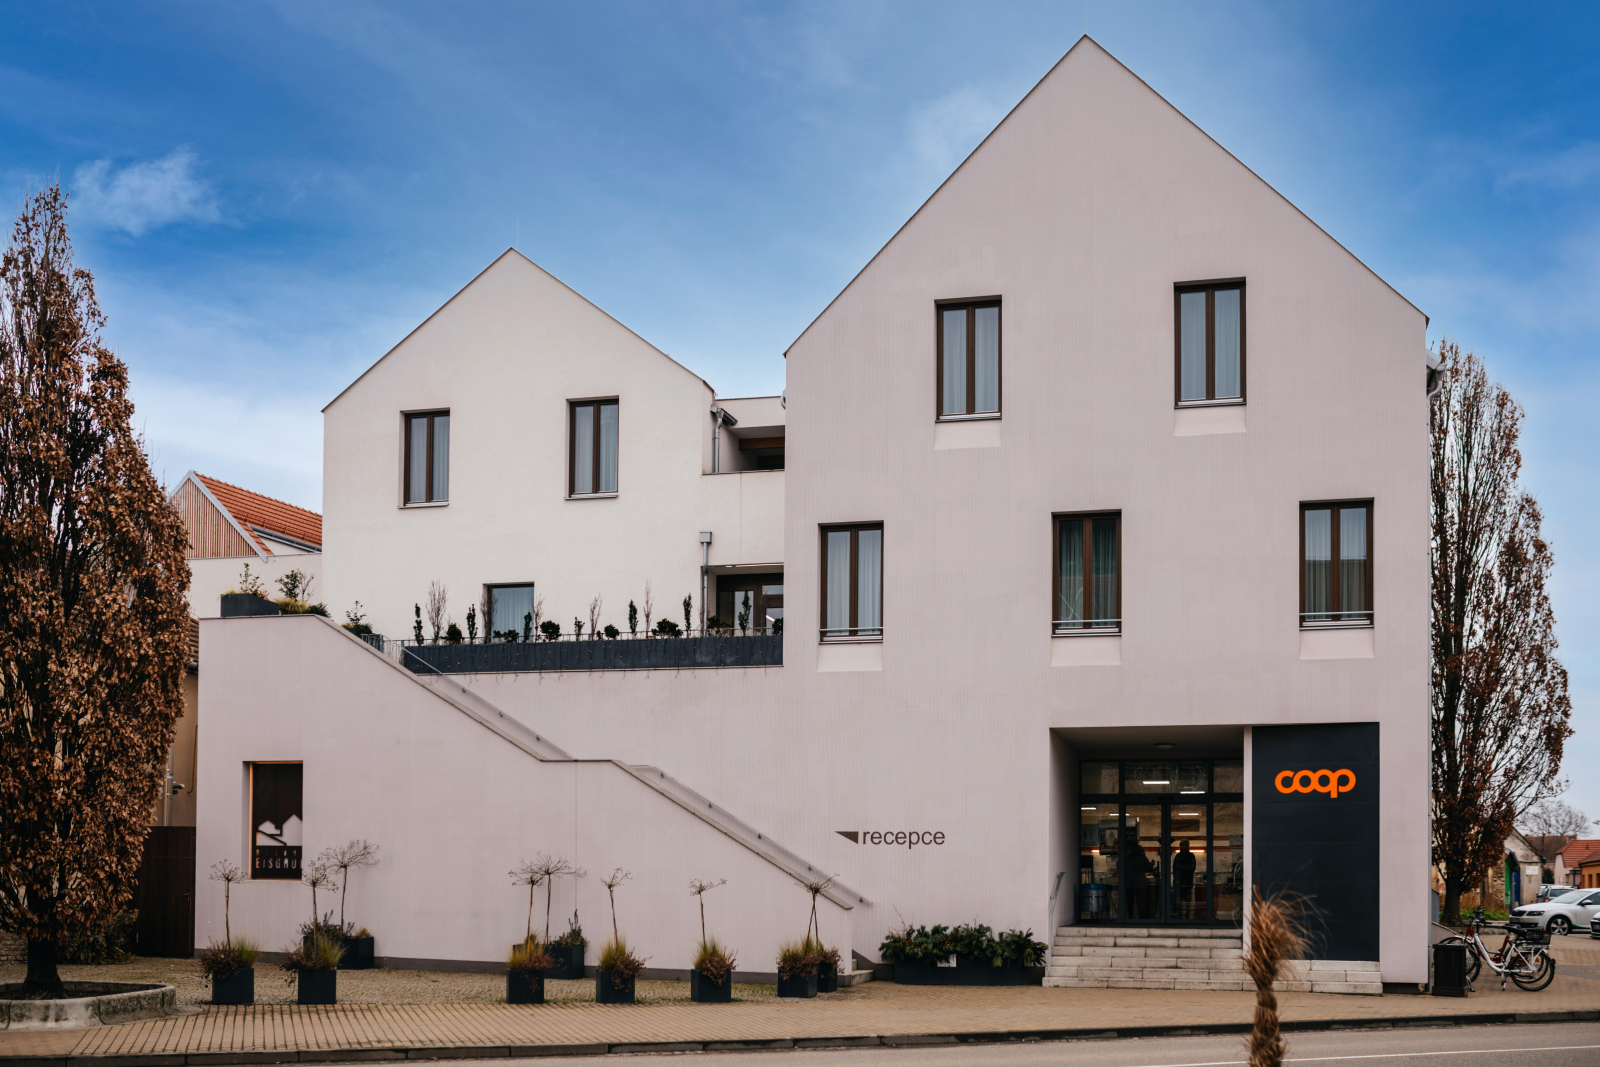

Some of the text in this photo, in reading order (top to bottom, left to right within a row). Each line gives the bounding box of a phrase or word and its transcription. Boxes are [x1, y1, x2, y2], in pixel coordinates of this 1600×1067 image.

[1274, 768, 1356, 798] coop
[862, 831, 945, 849] recepce
[255, 857, 302, 869] EISGRU
